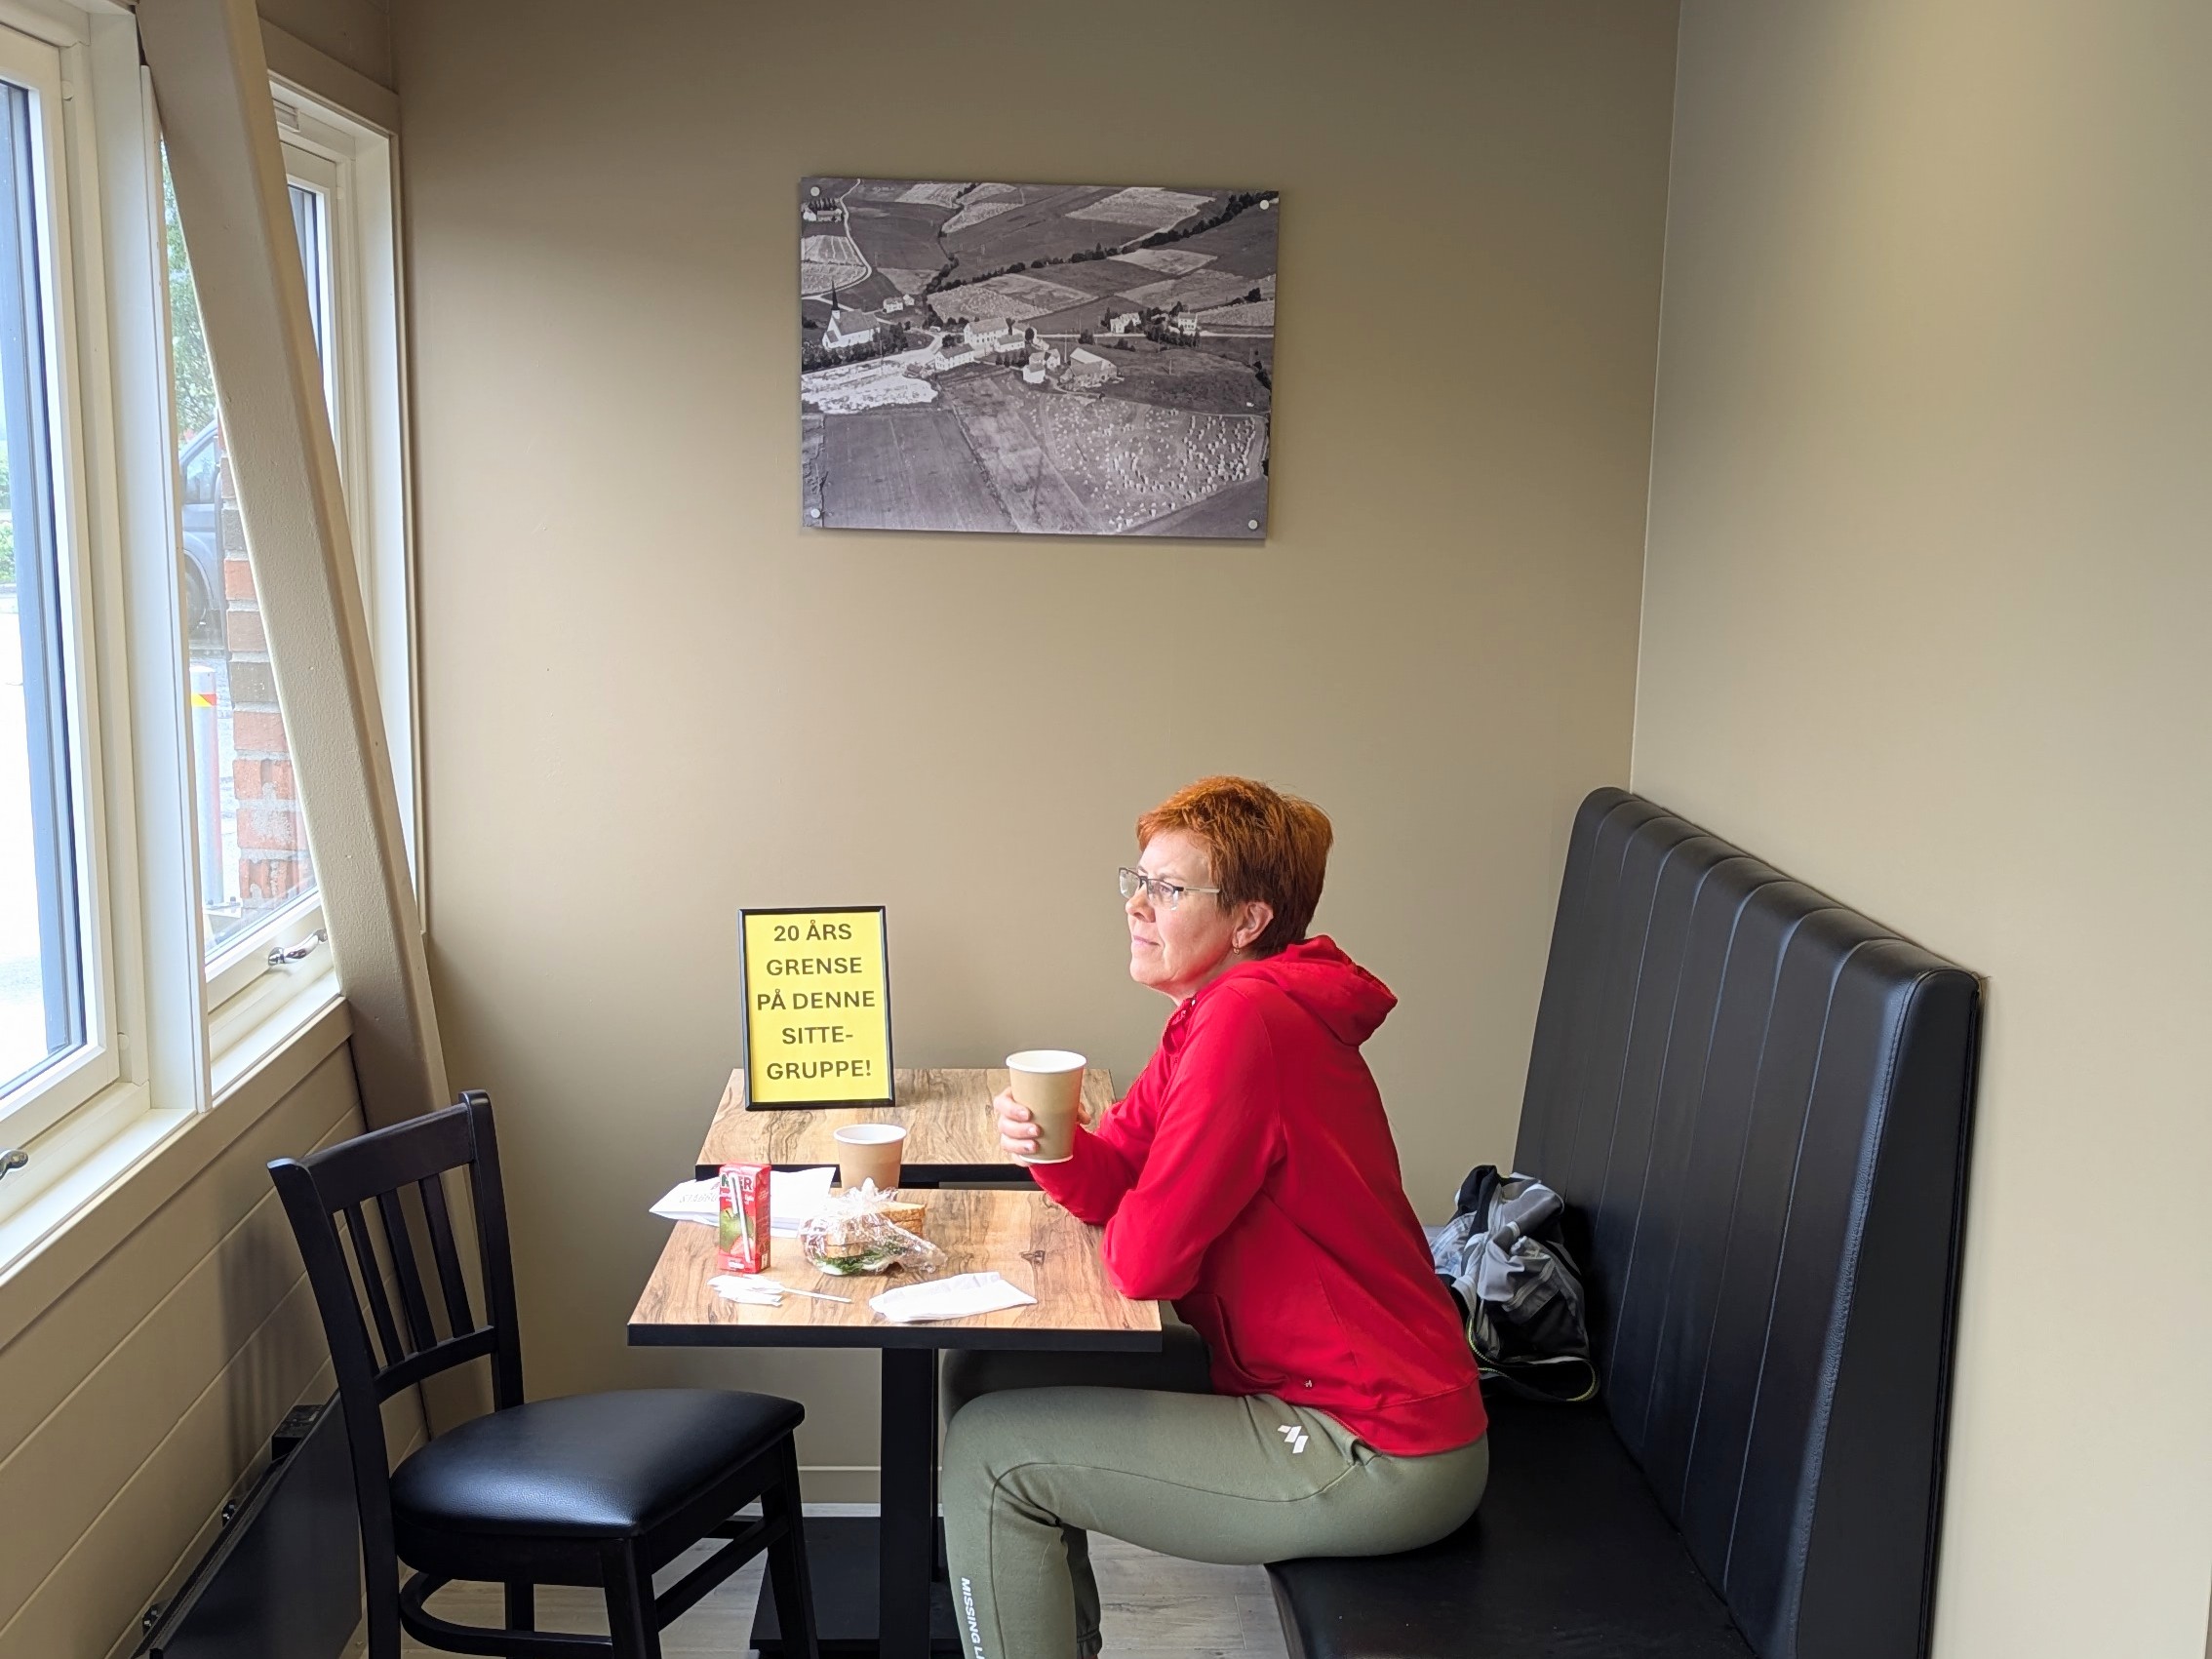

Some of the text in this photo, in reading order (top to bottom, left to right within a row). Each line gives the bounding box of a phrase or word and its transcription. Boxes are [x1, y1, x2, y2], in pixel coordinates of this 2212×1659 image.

[773, 919, 852, 942] 20 ÅRS
[766, 957, 863, 976] GRENSE
[757, 988, 876, 1010] PÅ DENNE
[781, 1026, 853, 1045] SITTE-
[767, 1060, 871, 1080] GRUPPE!
[961, 1577, 981, 1644] MISSING
